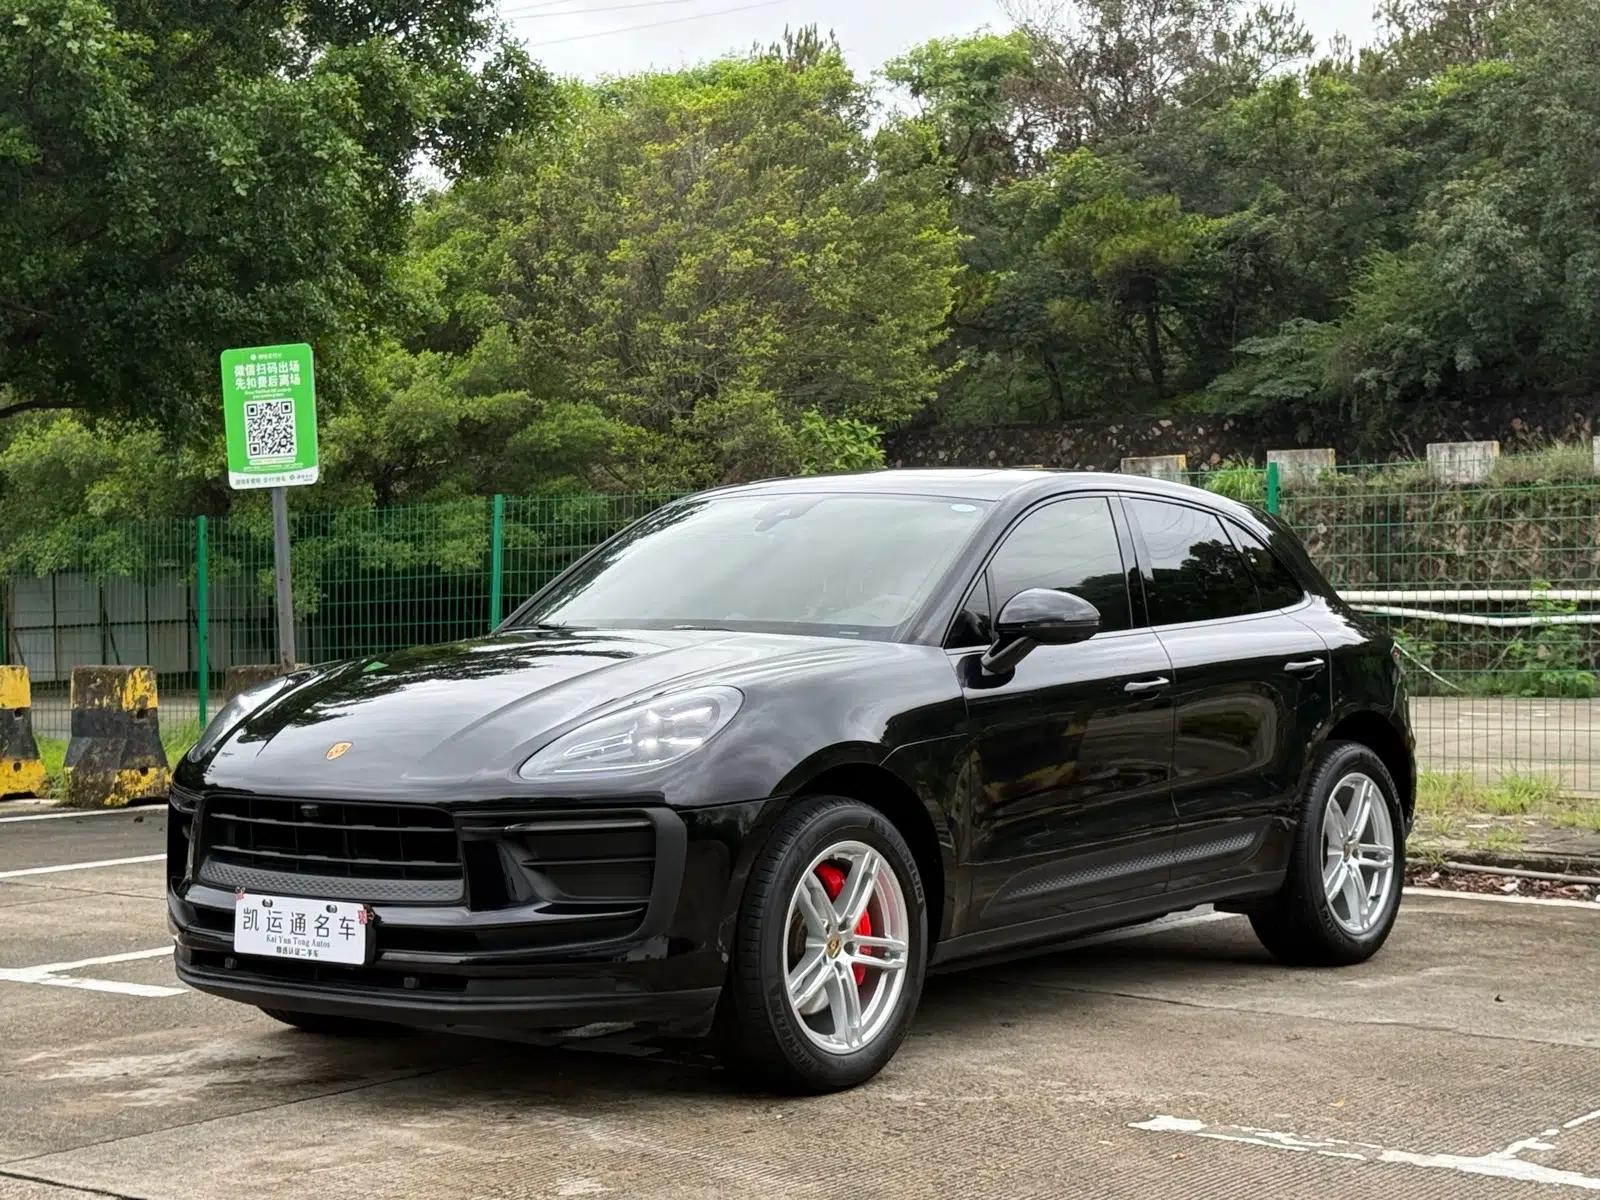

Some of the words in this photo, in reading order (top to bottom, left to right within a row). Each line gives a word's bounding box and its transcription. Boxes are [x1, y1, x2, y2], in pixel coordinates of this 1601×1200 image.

[234, 360, 300, 377] 微信扫码出场
[235, 373, 301, 390] 先扣费后离场
[243, 907, 356, 940] 凯运通名车
[266, 934, 277, 943] Kai
[278, 936, 291, 945] Yun
[293, 937, 310, 948] Tong
[311, 939, 330, 949] Autos
